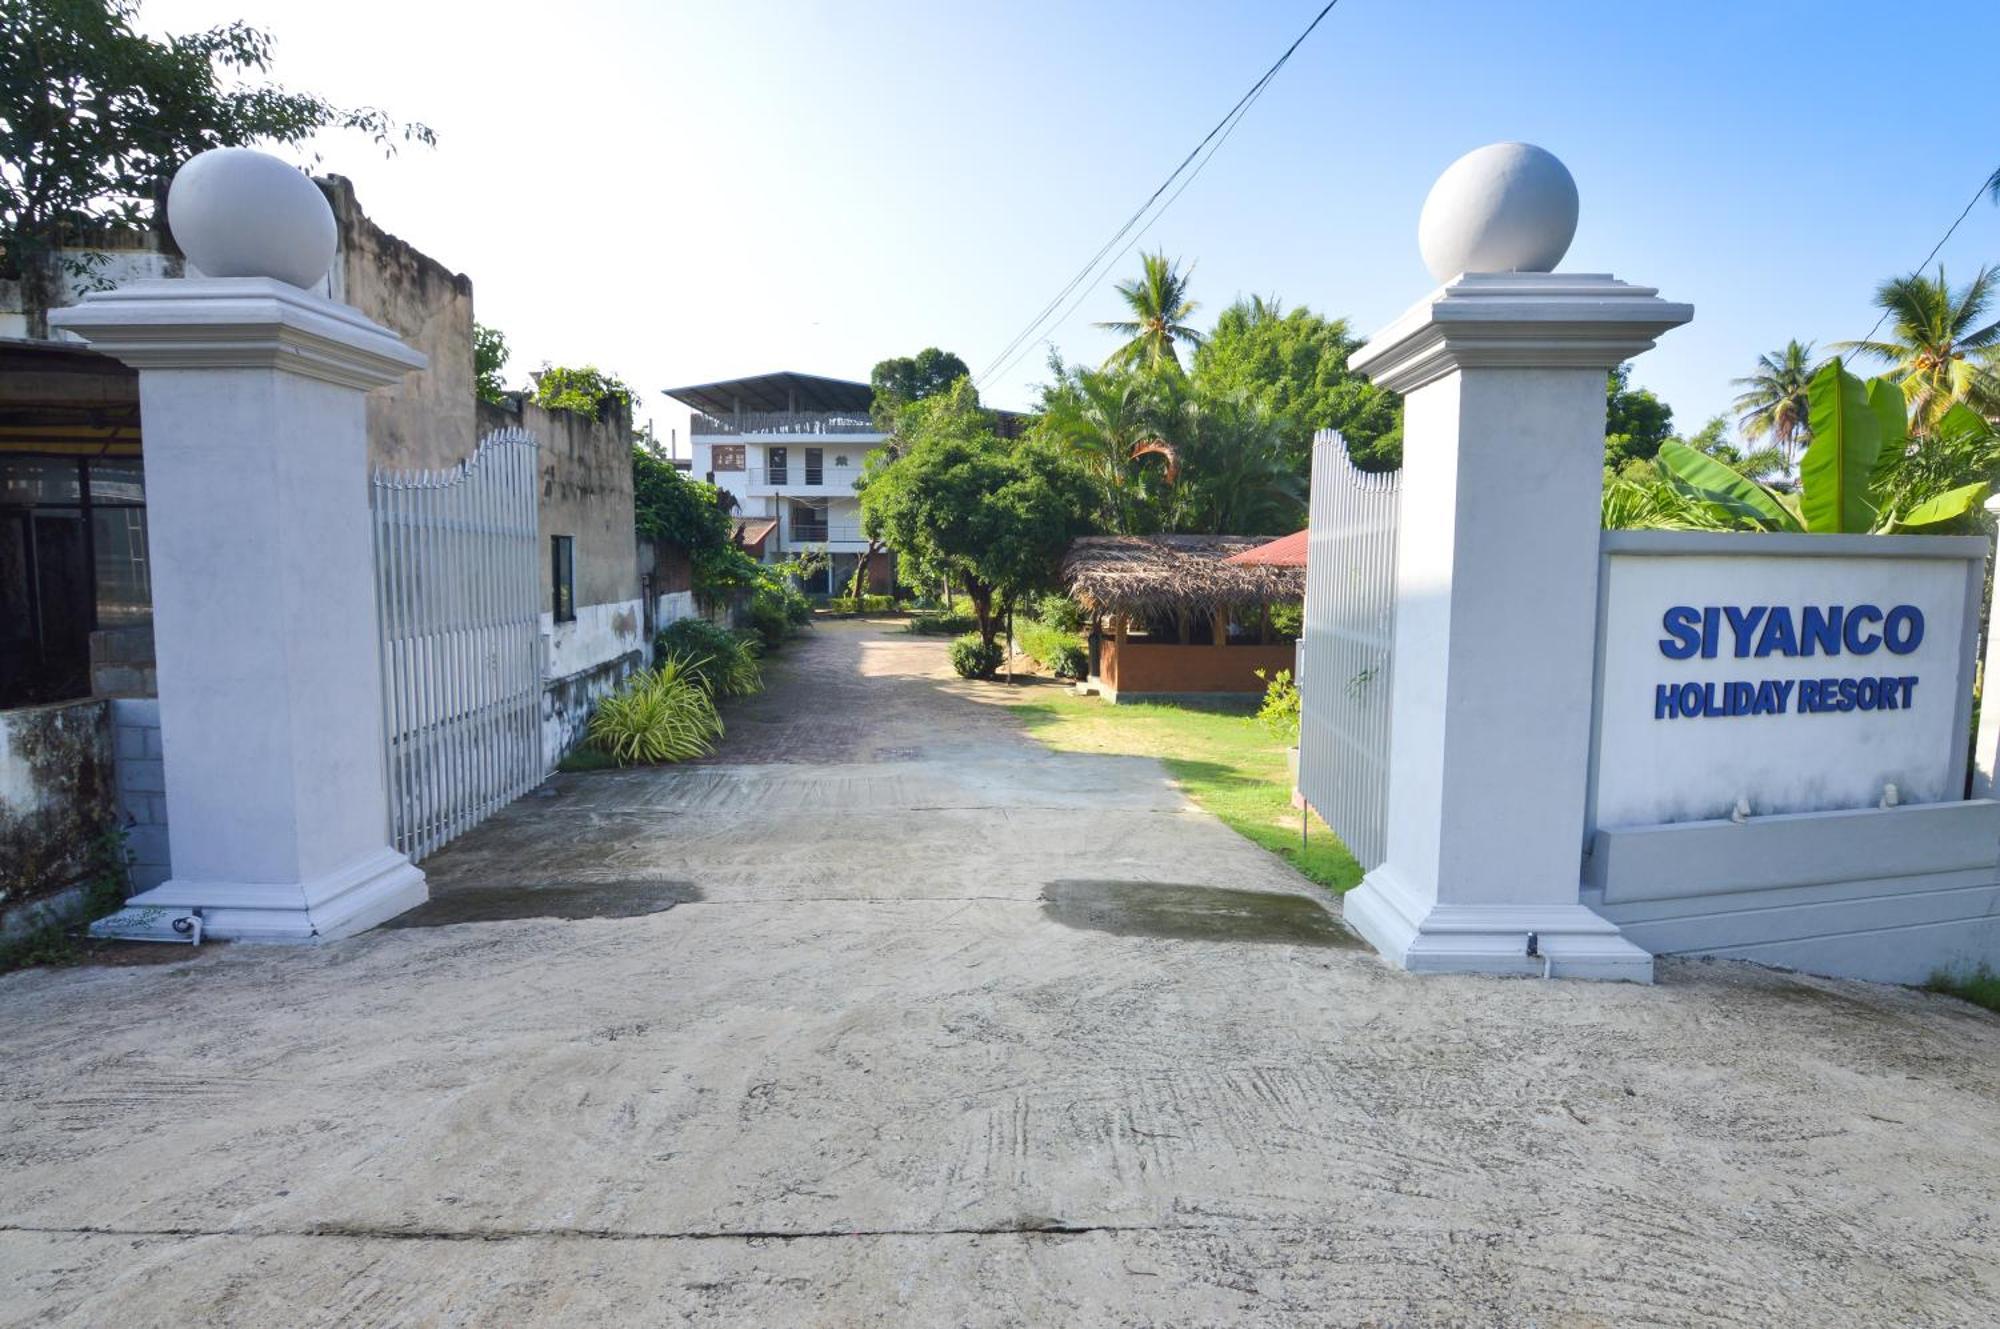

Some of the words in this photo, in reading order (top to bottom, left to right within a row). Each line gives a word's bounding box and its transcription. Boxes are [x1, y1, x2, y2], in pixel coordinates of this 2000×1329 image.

[1659, 604, 1925, 660] SIYANCO
[1655, 679, 1795, 720] HOLIDAY
[1797, 676, 1919, 714] RESORT
